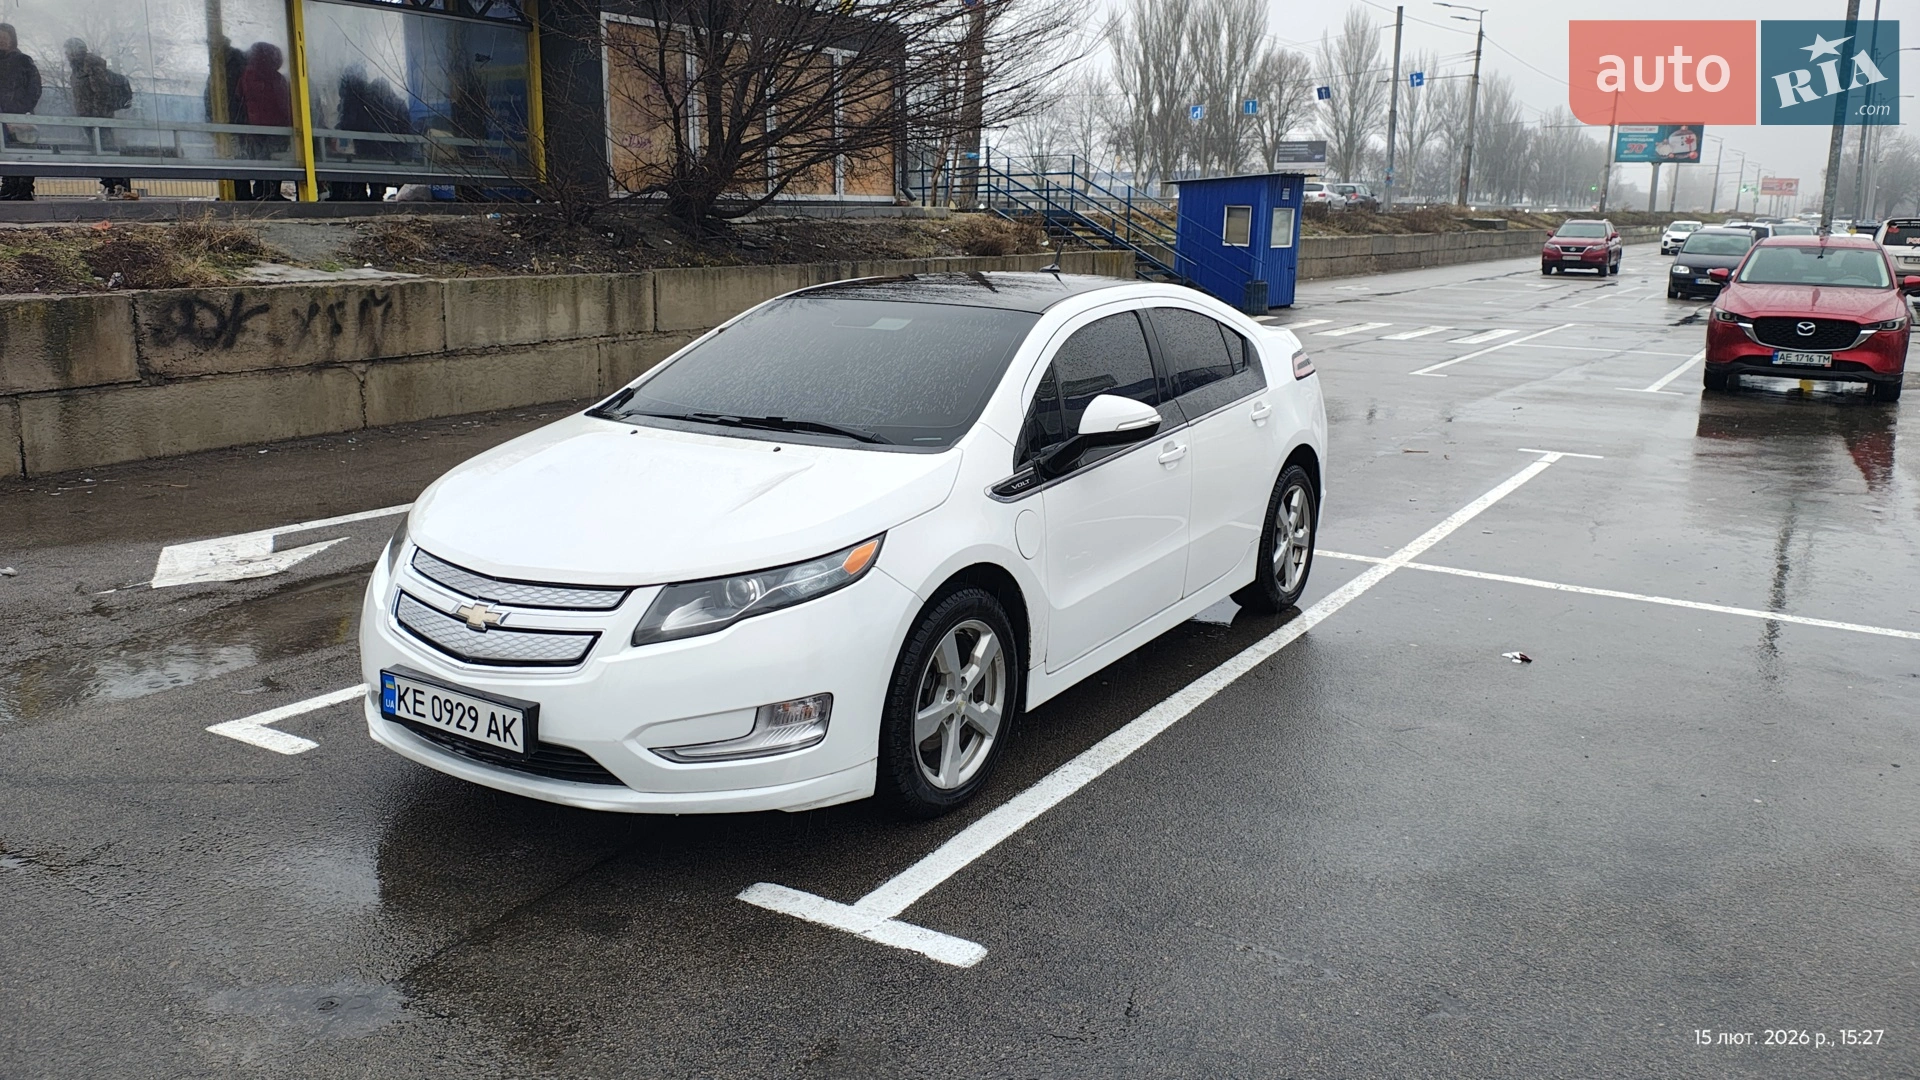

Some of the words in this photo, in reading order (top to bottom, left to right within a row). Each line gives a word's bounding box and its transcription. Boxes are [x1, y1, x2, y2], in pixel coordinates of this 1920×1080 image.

[1779, 353, 1792, 361] AE
[1795, 354, 1814, 362] 1716
[1816, 355, 1831, 363] TM
[1011, 479, 1030, 489] VOLT
[385, 698, 395, 709] UA
[397, 684, 426, 718] KE
[431, 695, 479, 733] 0929
[487, 711, 518, 746] AK
